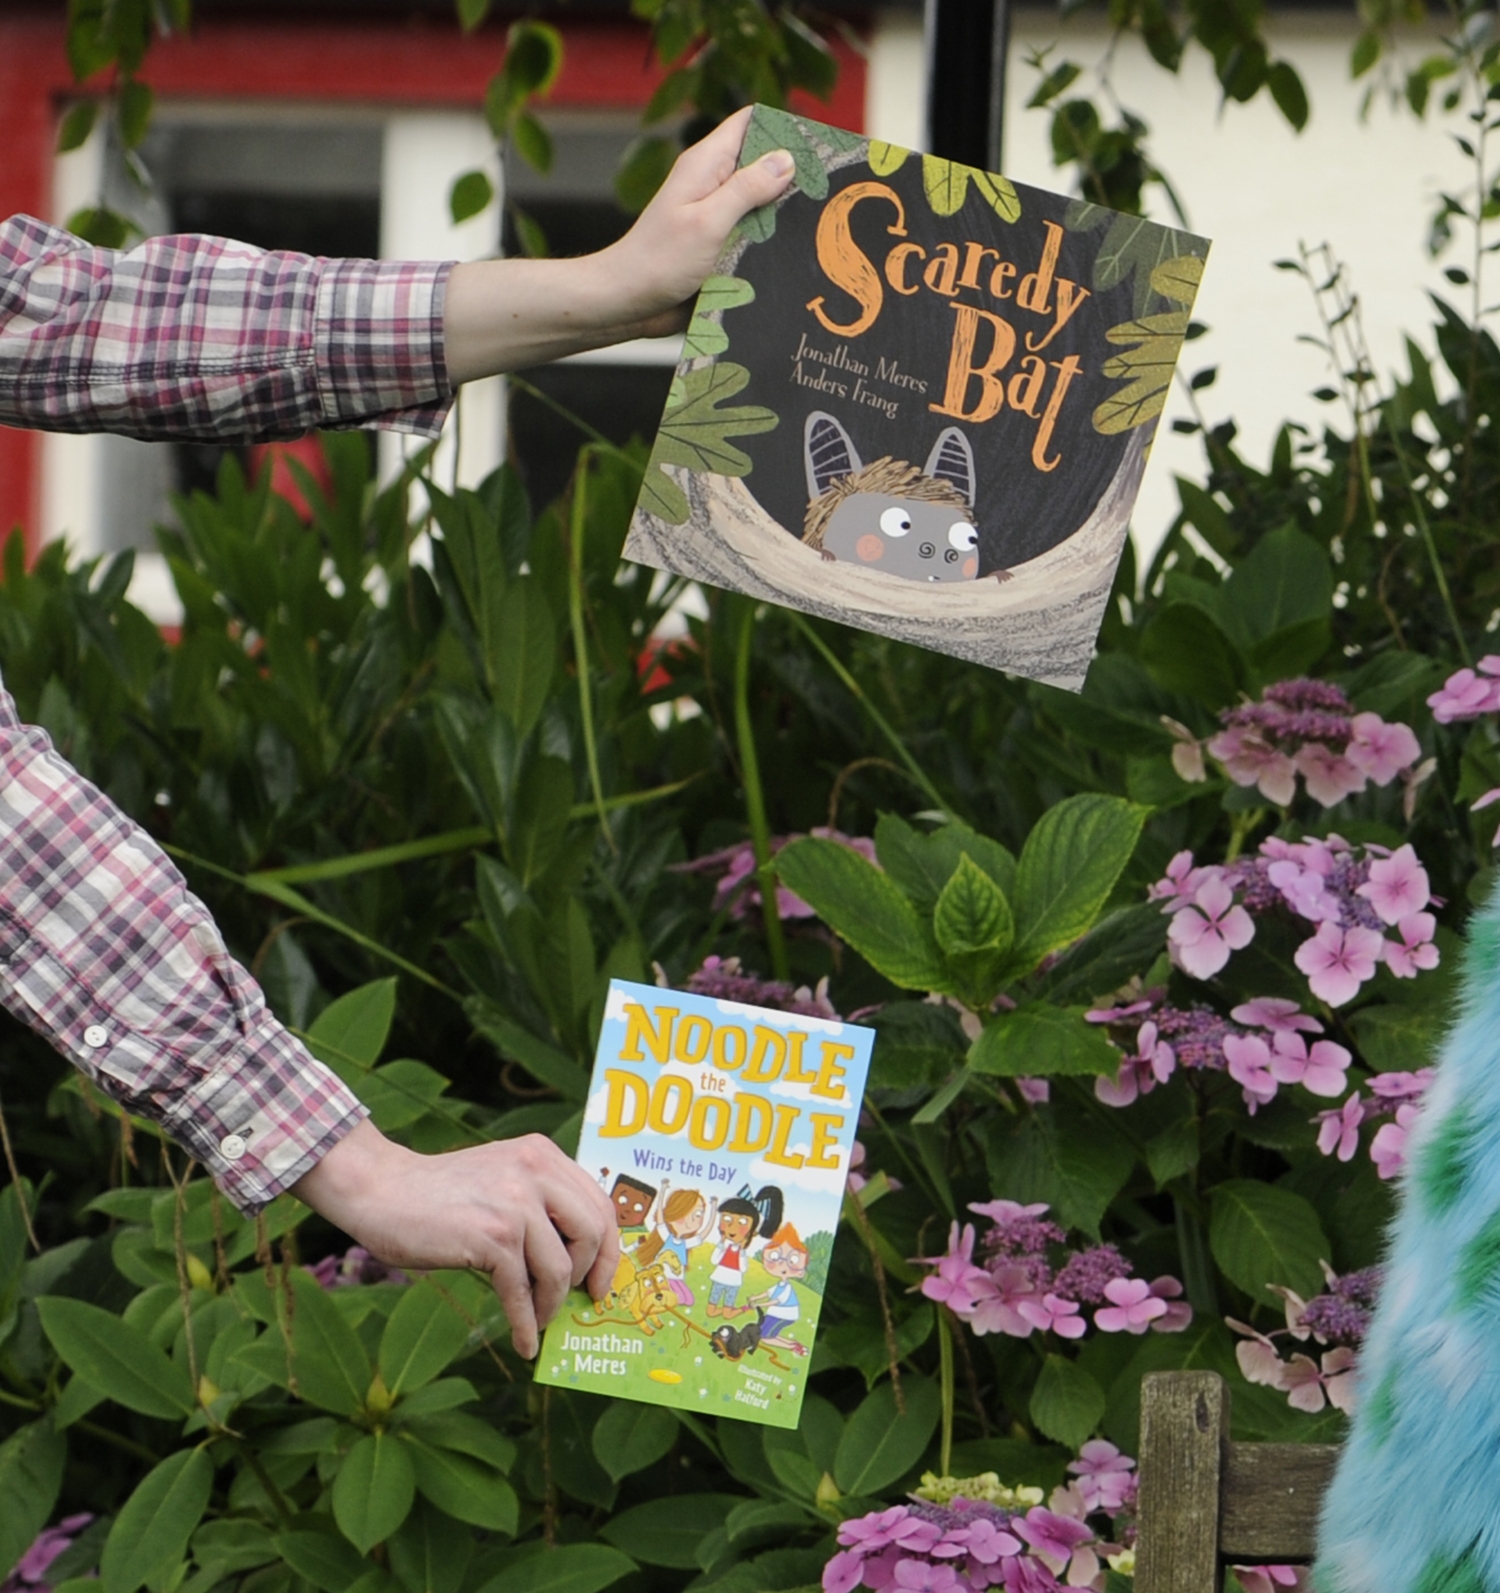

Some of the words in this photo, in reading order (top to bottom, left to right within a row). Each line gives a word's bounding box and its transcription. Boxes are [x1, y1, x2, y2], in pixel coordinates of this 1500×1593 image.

[805, 181, 1091, 351] Scaredy
[789, 361, 848, 398] Anders
[852, 378, 899, 419] Frang
[790, 332, 869, 377] Jonathan
[874, 356, 928, 394] Meres
[928, 301, 1083, 472] Bat
[618, 1003, 855, 1100] NOODLE
[700, 1072, 726, 1093] the
[597, 1067, 845, 1170] DOODLE
[632, 1148, 673, 1172] Wins
[680, 1158, 703, 1177] the
[708, 1161, 737, 1185] Day
[560, 1330, 644, 1354] Jonathan
[574, 1352, 627, 1375] Meres
